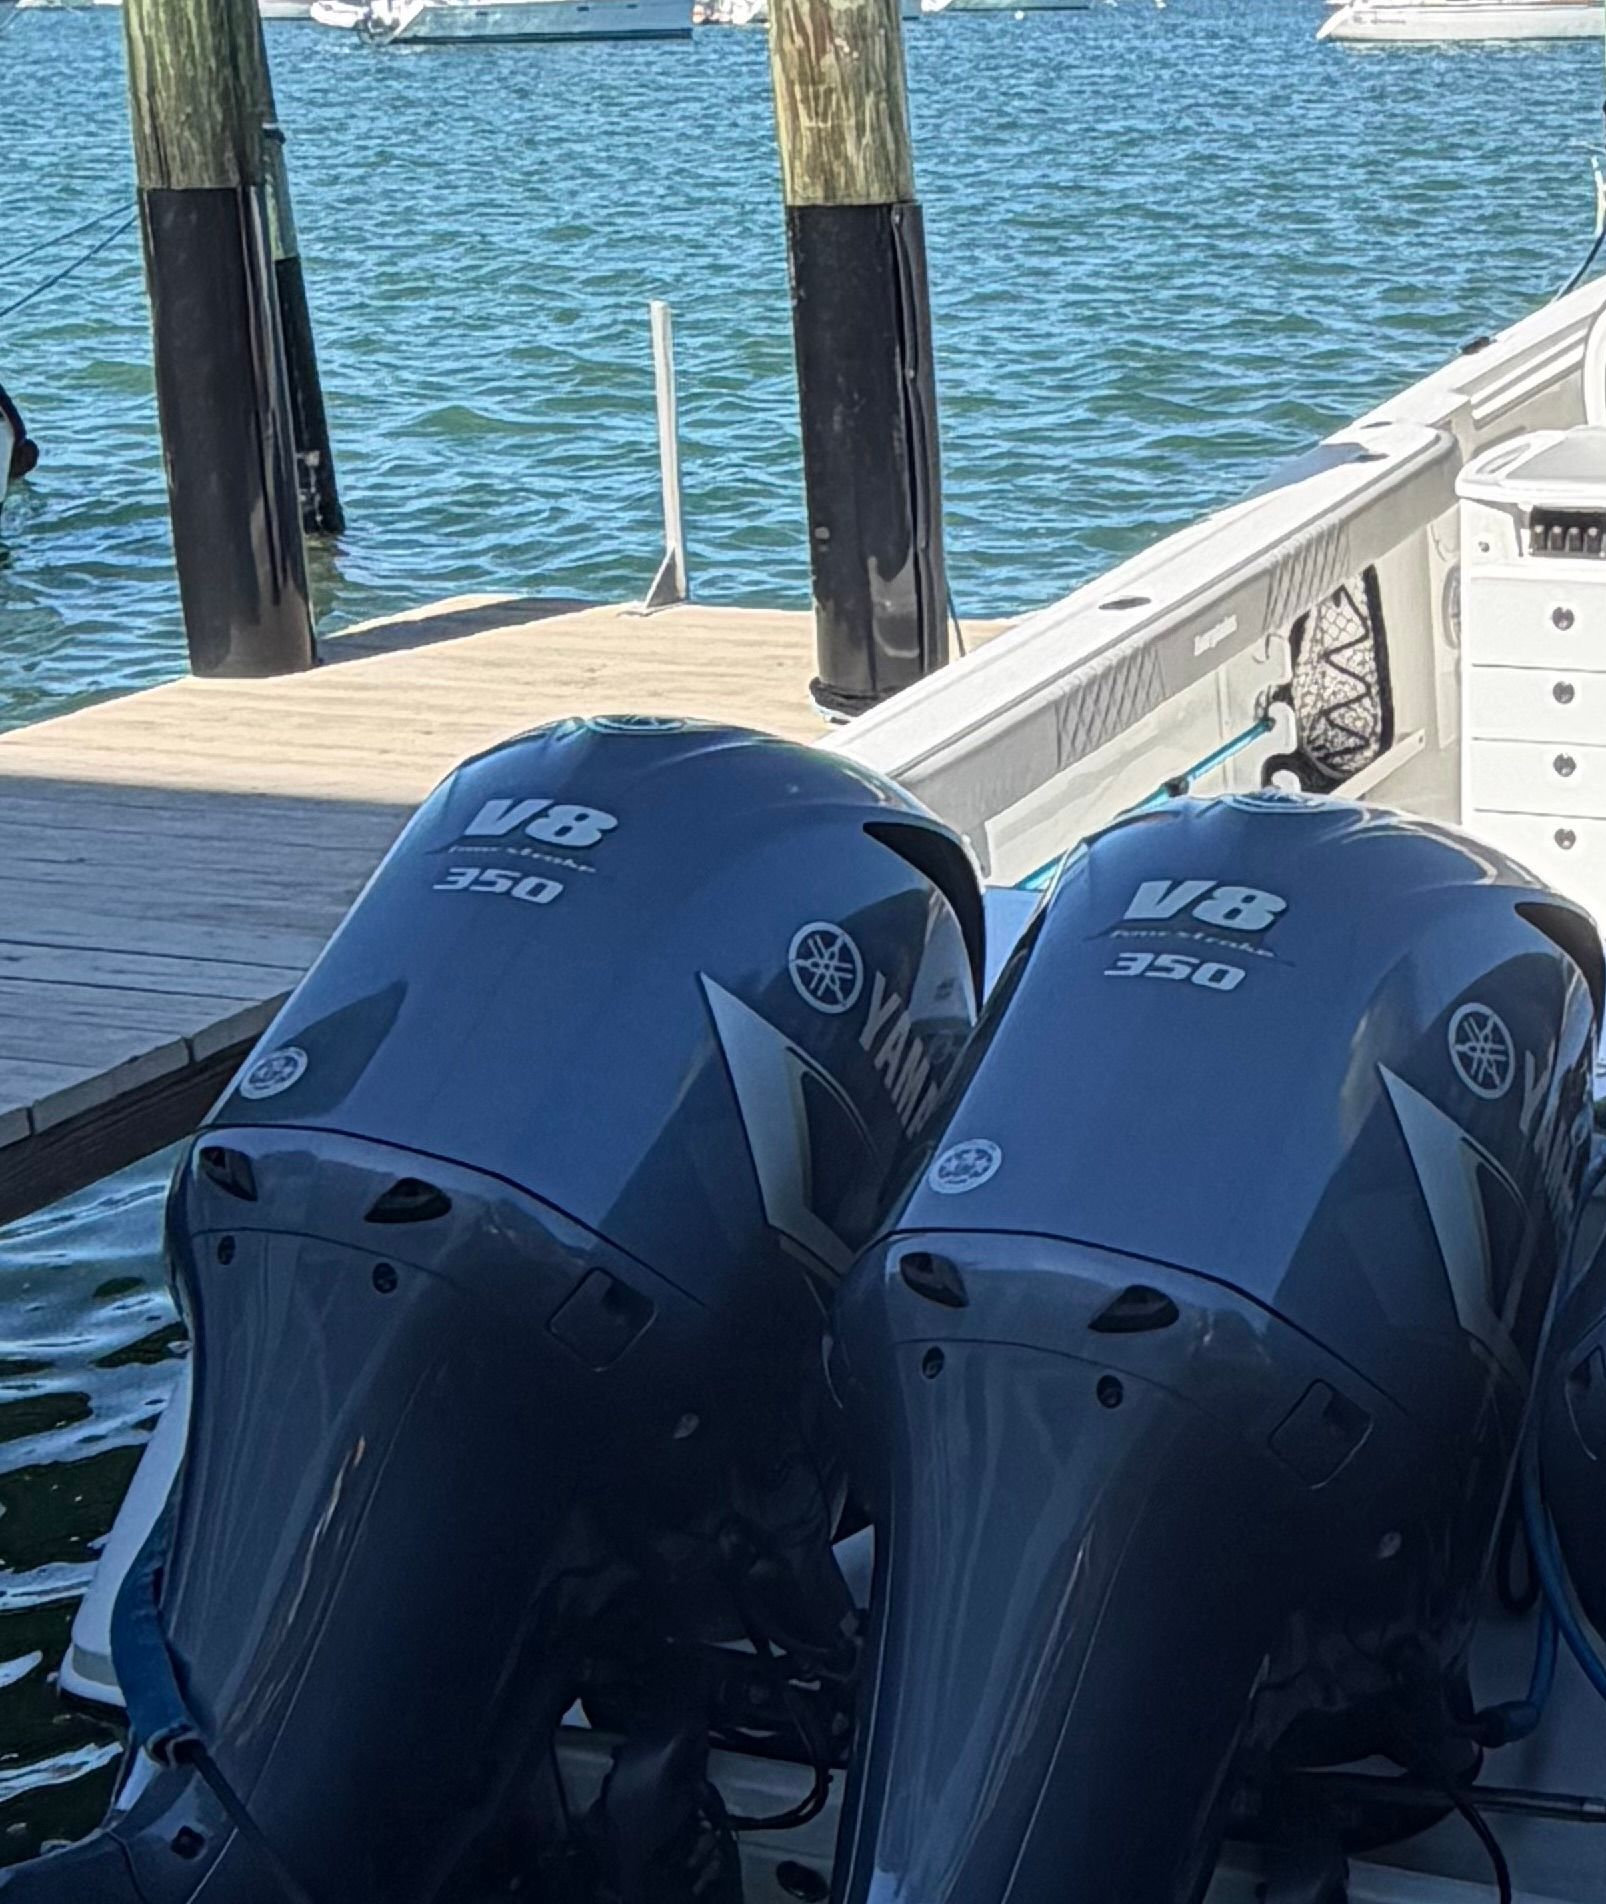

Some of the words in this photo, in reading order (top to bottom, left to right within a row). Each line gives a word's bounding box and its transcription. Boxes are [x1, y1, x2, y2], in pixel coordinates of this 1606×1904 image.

[463, 798, 619, 847] V8
[432, 867, 565, 905] 350
[1123, 879, 1288, 931] V8
[1103, 952, 1247, 992] 350
